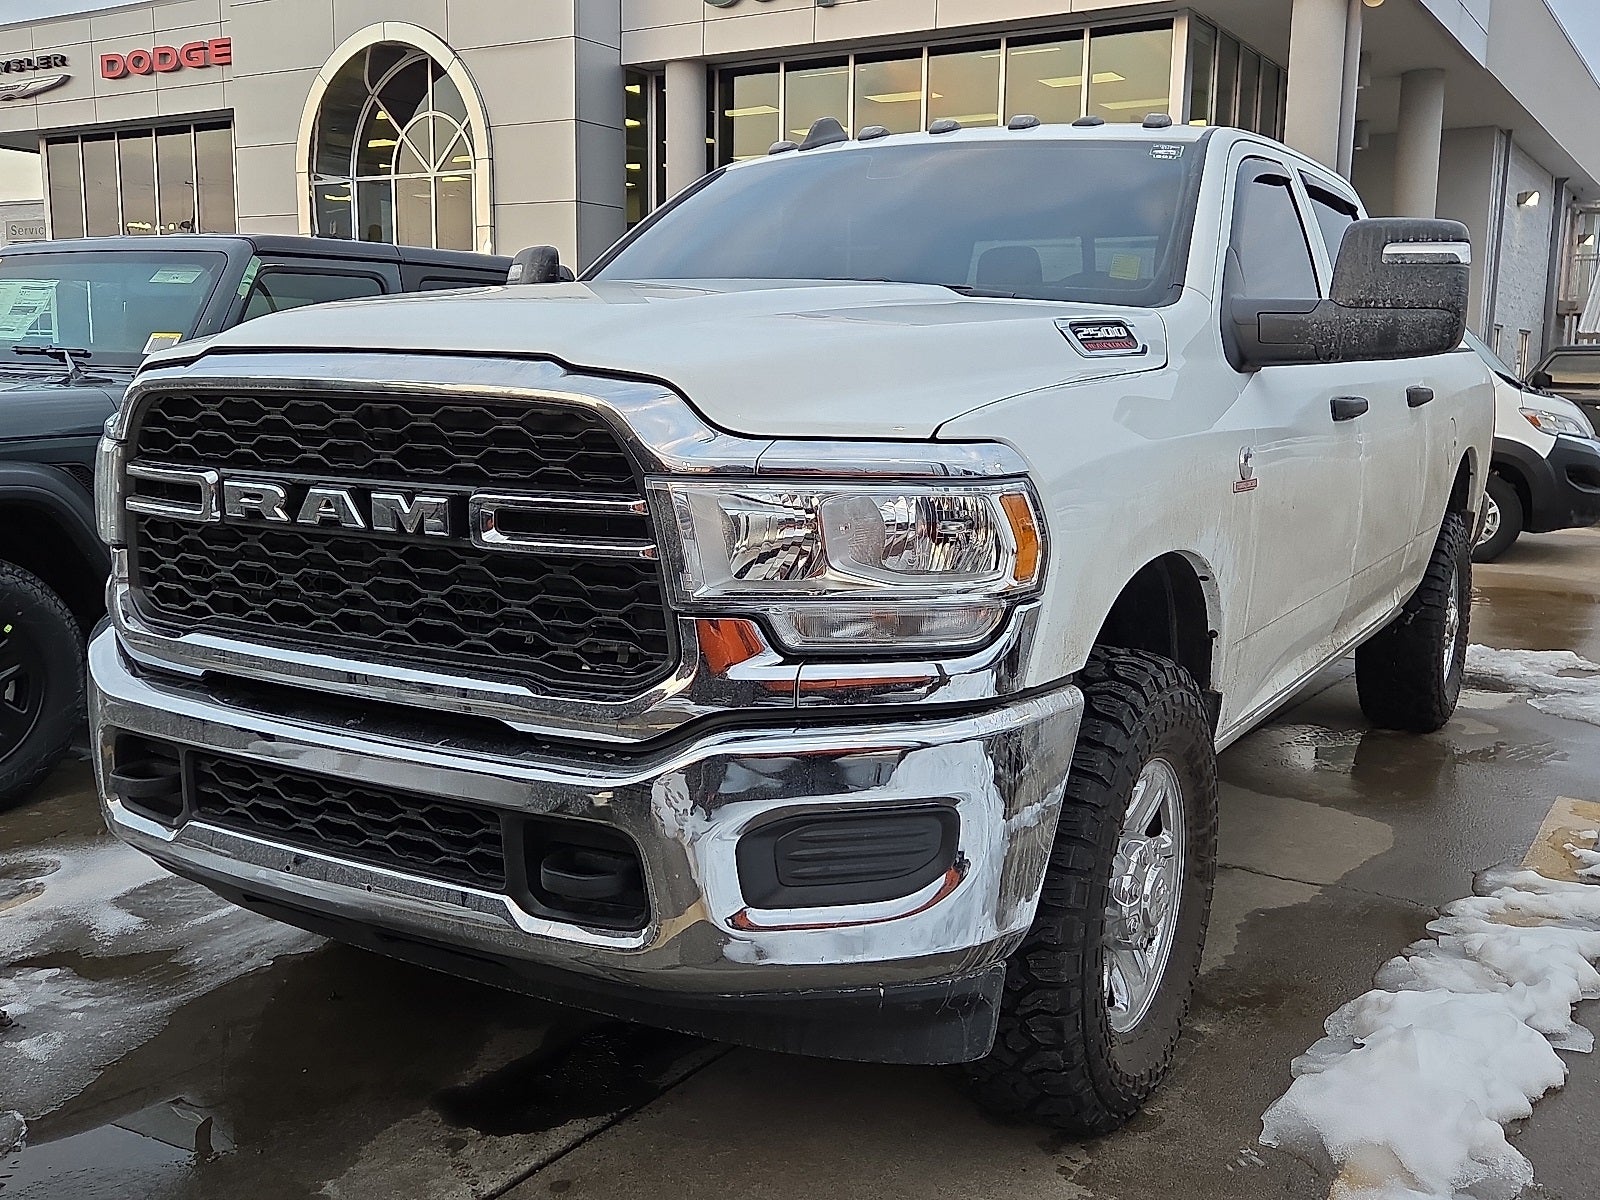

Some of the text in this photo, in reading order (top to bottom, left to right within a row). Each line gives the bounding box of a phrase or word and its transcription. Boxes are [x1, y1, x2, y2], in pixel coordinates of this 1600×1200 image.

[100, 37, 232, 79] DODGE
[10, 224, 44, 236] Servic
[1075, 326, 1128, 340] 2500
[222, 479, 449, 537] RAM
